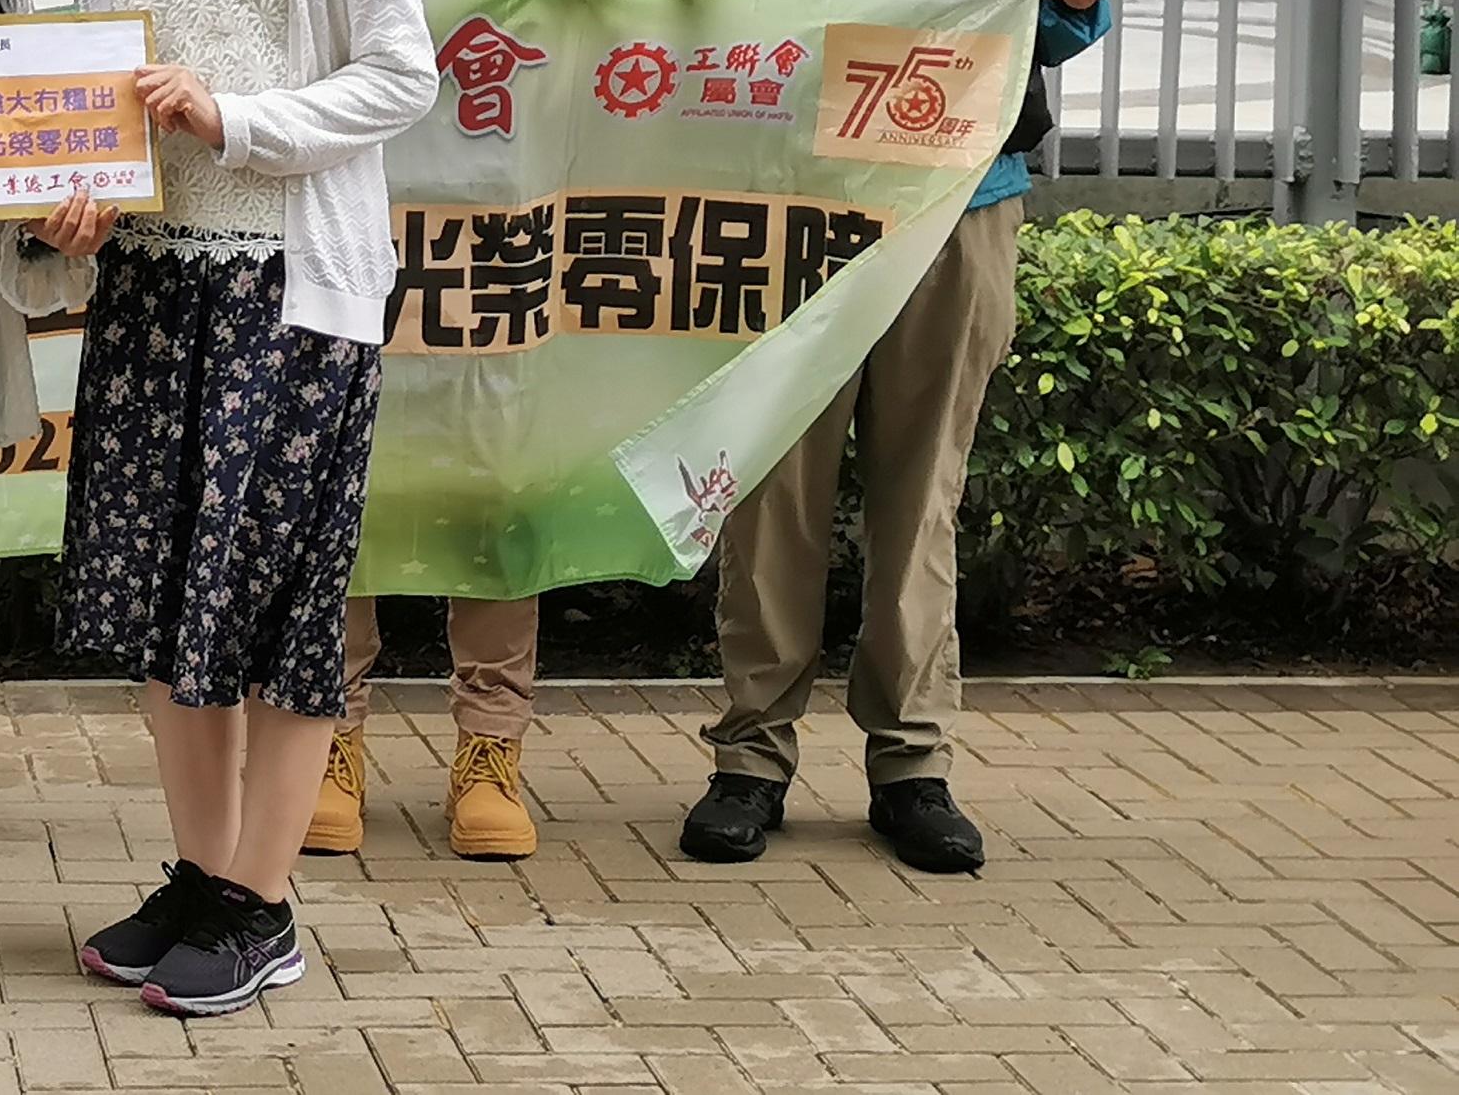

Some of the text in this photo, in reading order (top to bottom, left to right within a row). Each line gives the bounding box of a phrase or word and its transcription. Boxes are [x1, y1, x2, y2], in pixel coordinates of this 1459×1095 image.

[436, 17, 547, 135] 會
[686, 39, 810, 78] 工聯會
